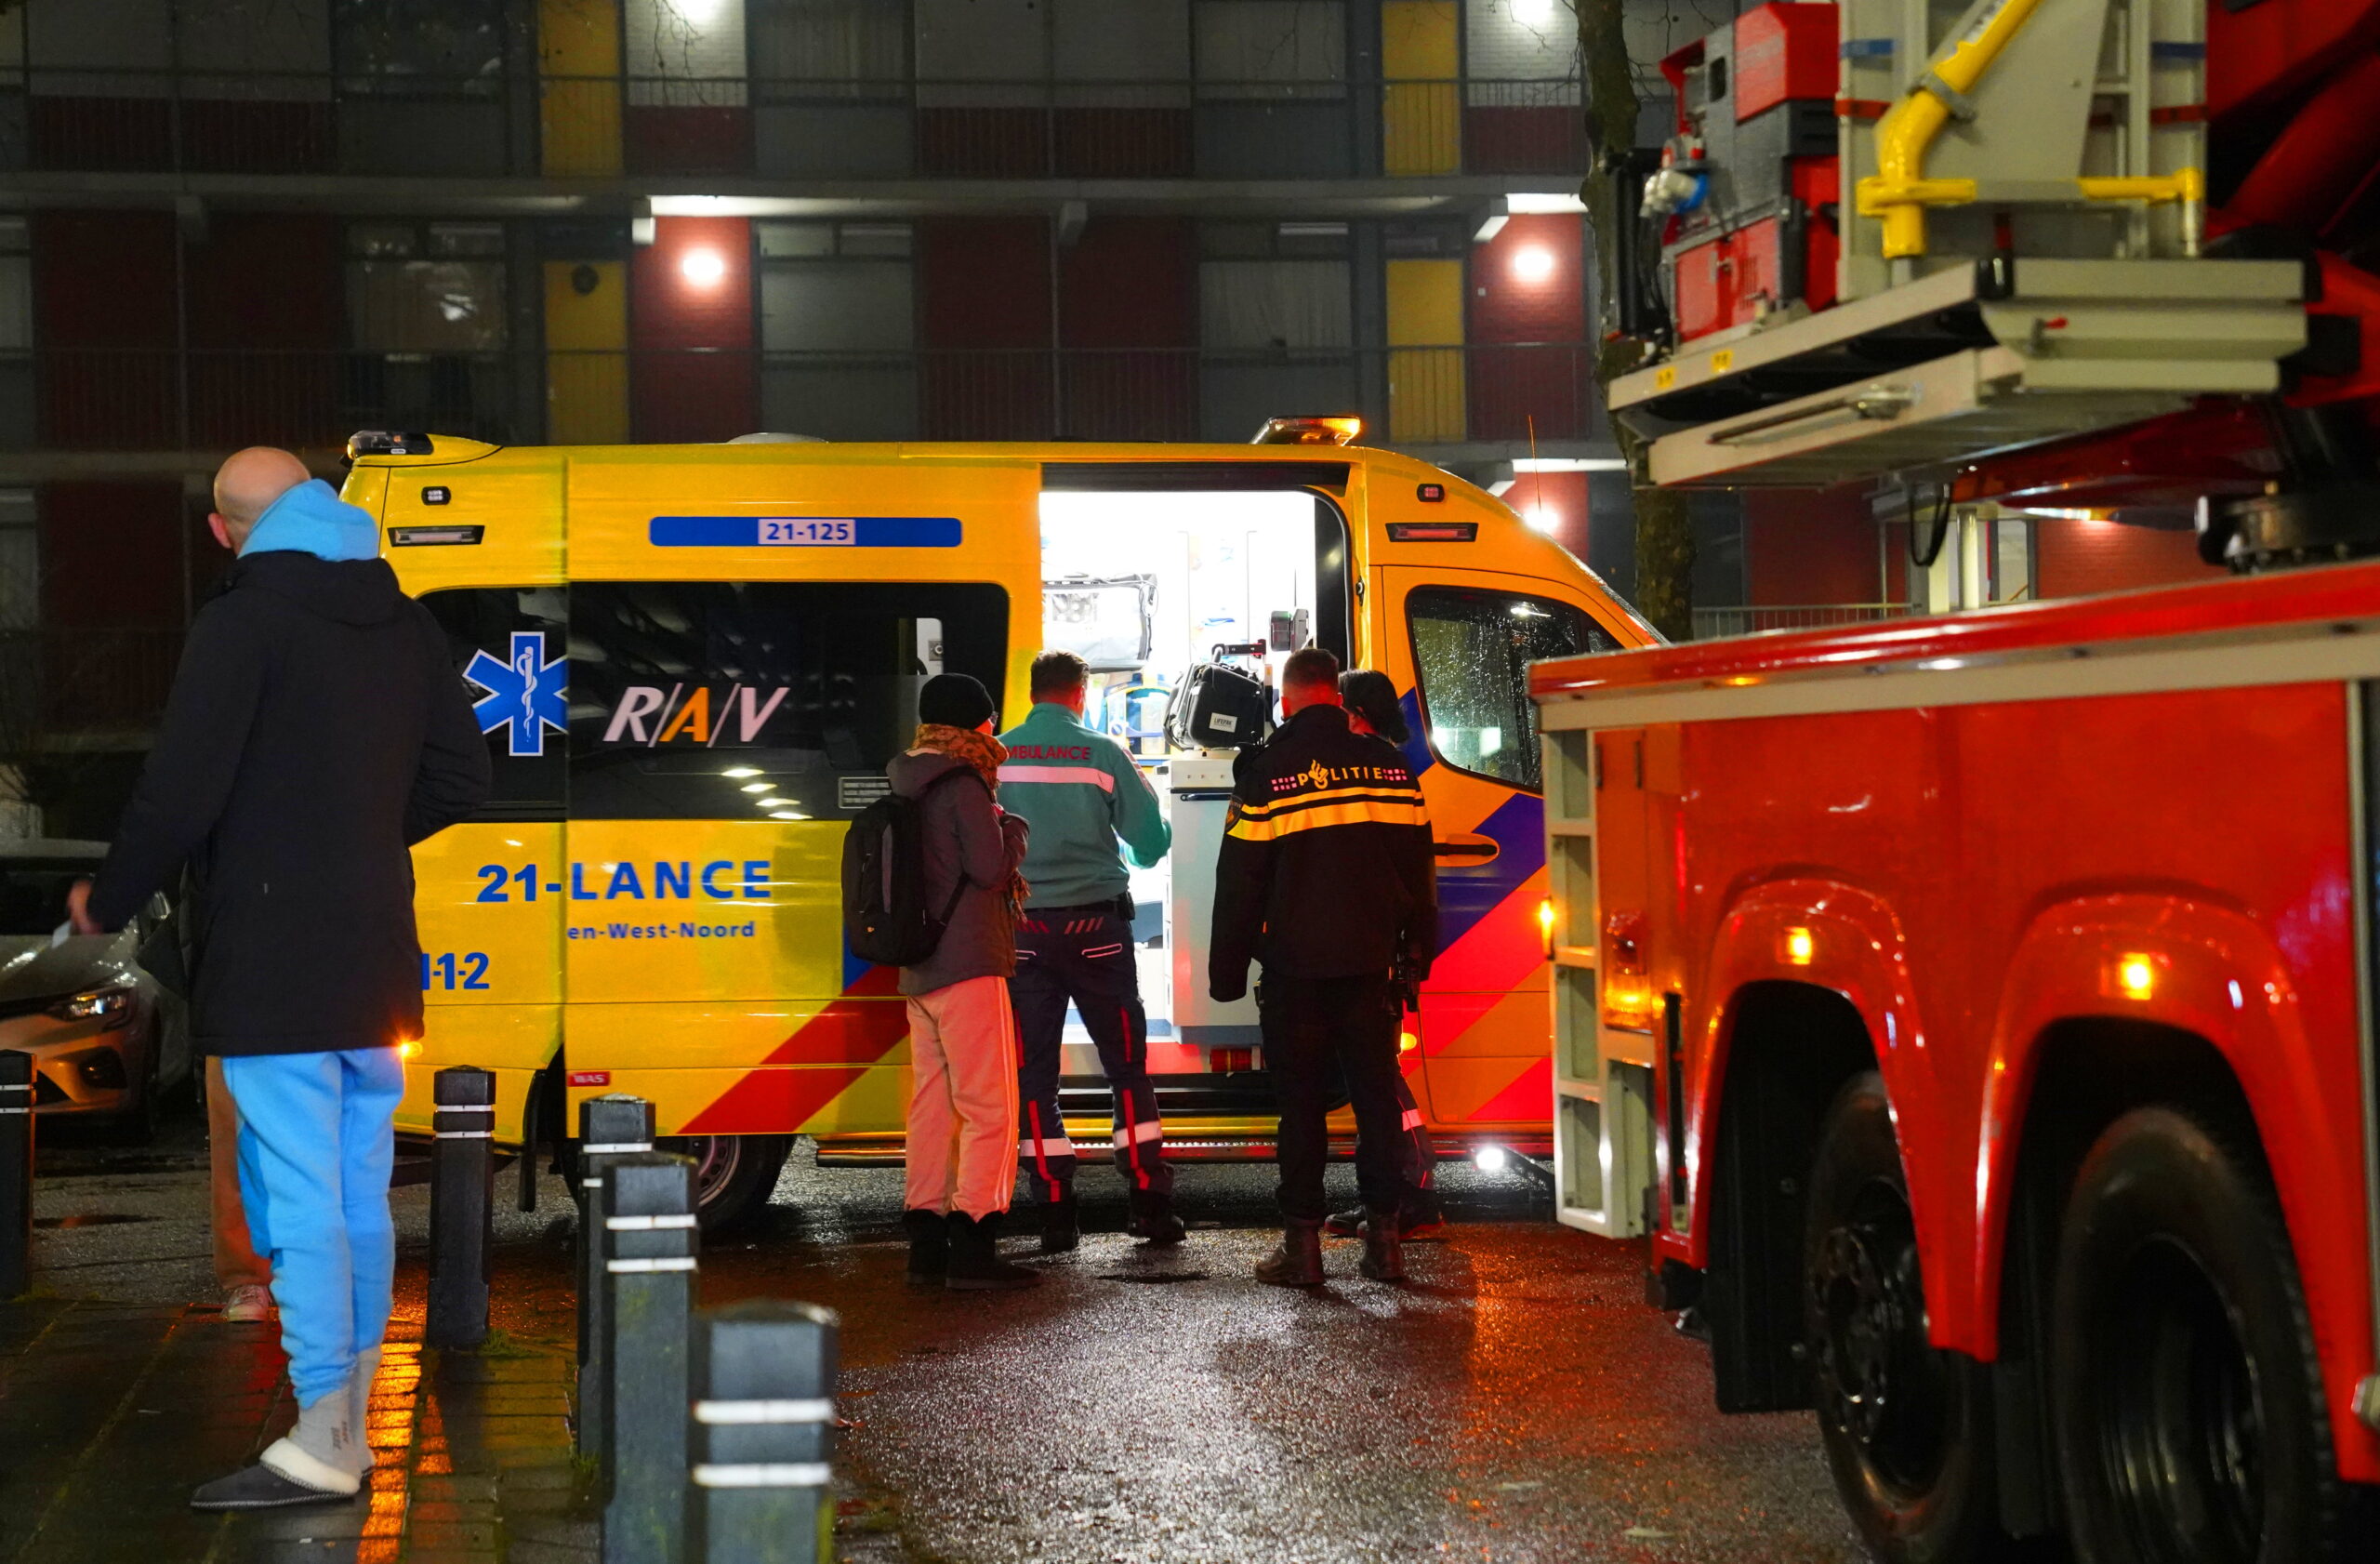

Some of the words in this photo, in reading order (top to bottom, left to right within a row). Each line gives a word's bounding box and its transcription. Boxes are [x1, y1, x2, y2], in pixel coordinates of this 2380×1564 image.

[766, 523, 848, 540] 21-125
[1007, 745, 1091, 761] MBULANCE
[1297, 760, 1383, 789] POLITIE
[567, 921, 755, 939] en-West-Noord
